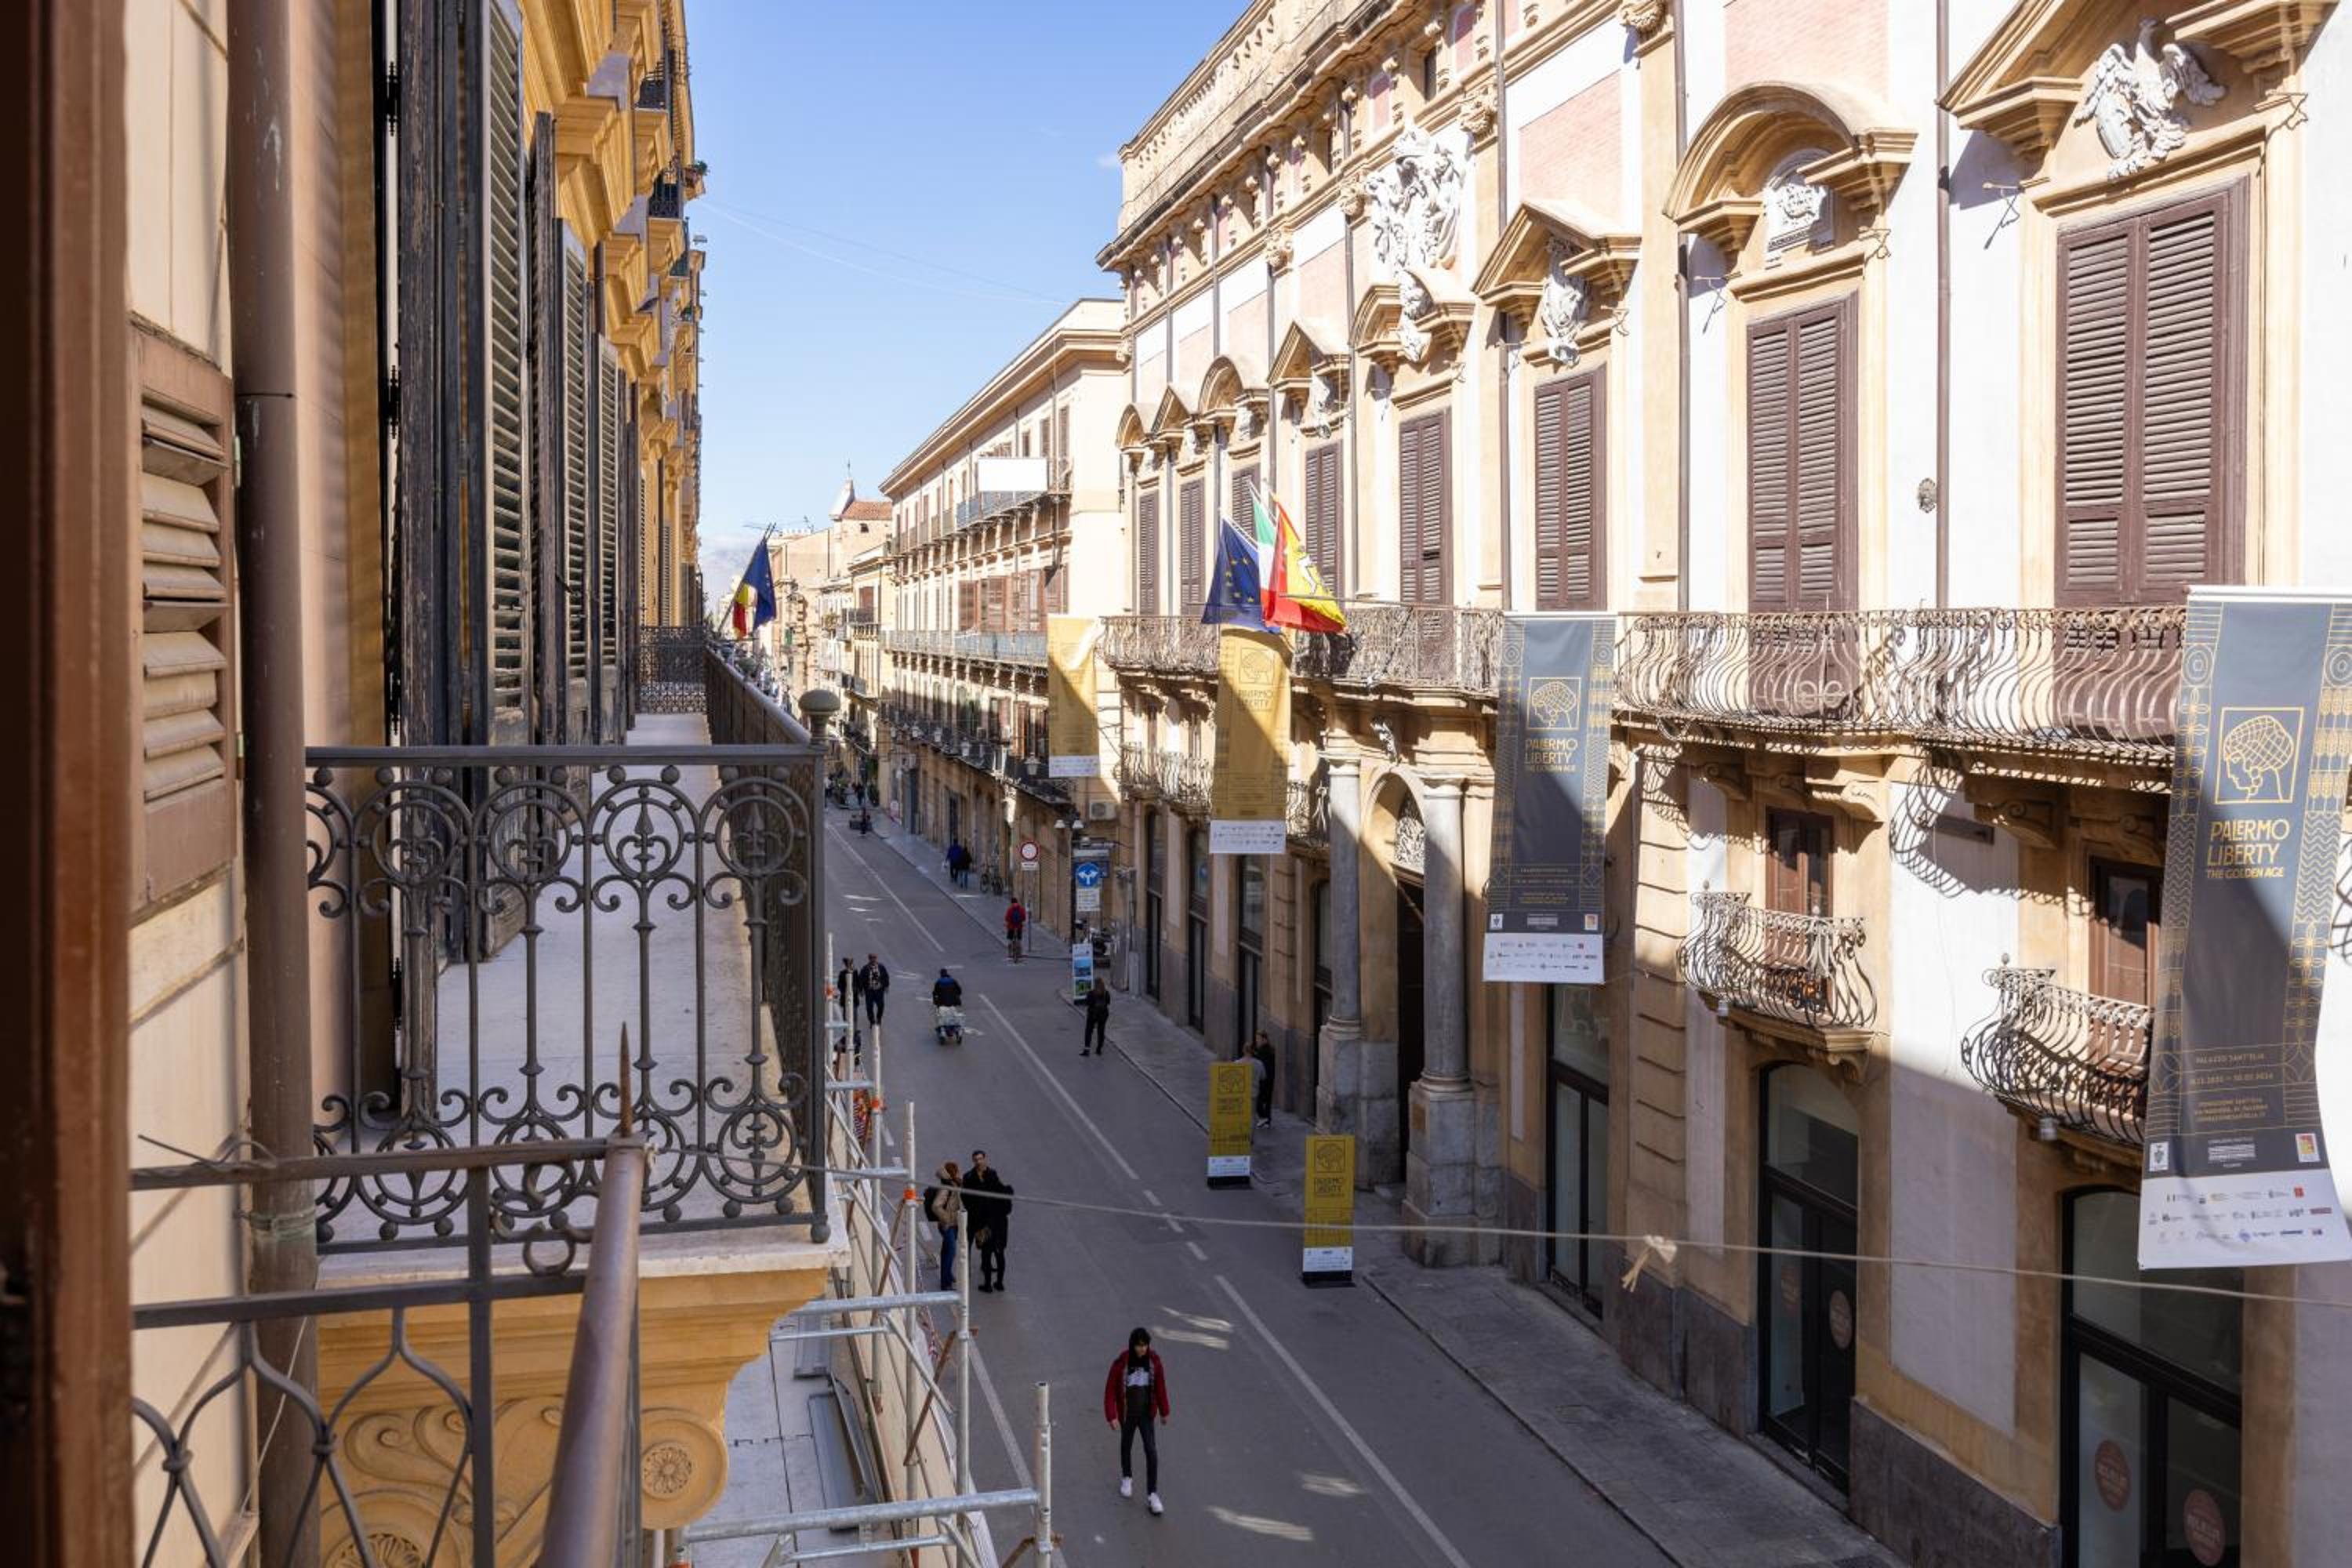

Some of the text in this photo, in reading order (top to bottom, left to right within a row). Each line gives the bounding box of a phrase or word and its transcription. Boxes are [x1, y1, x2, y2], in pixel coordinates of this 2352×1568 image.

[1525, 739, 1577, 751] PALERMO
[1524, 752, 1573, 764] LIBERTY
[2210, 818, 2289, 841] PALERMO
[2207, 843, 2280, 866] LIBERTY
